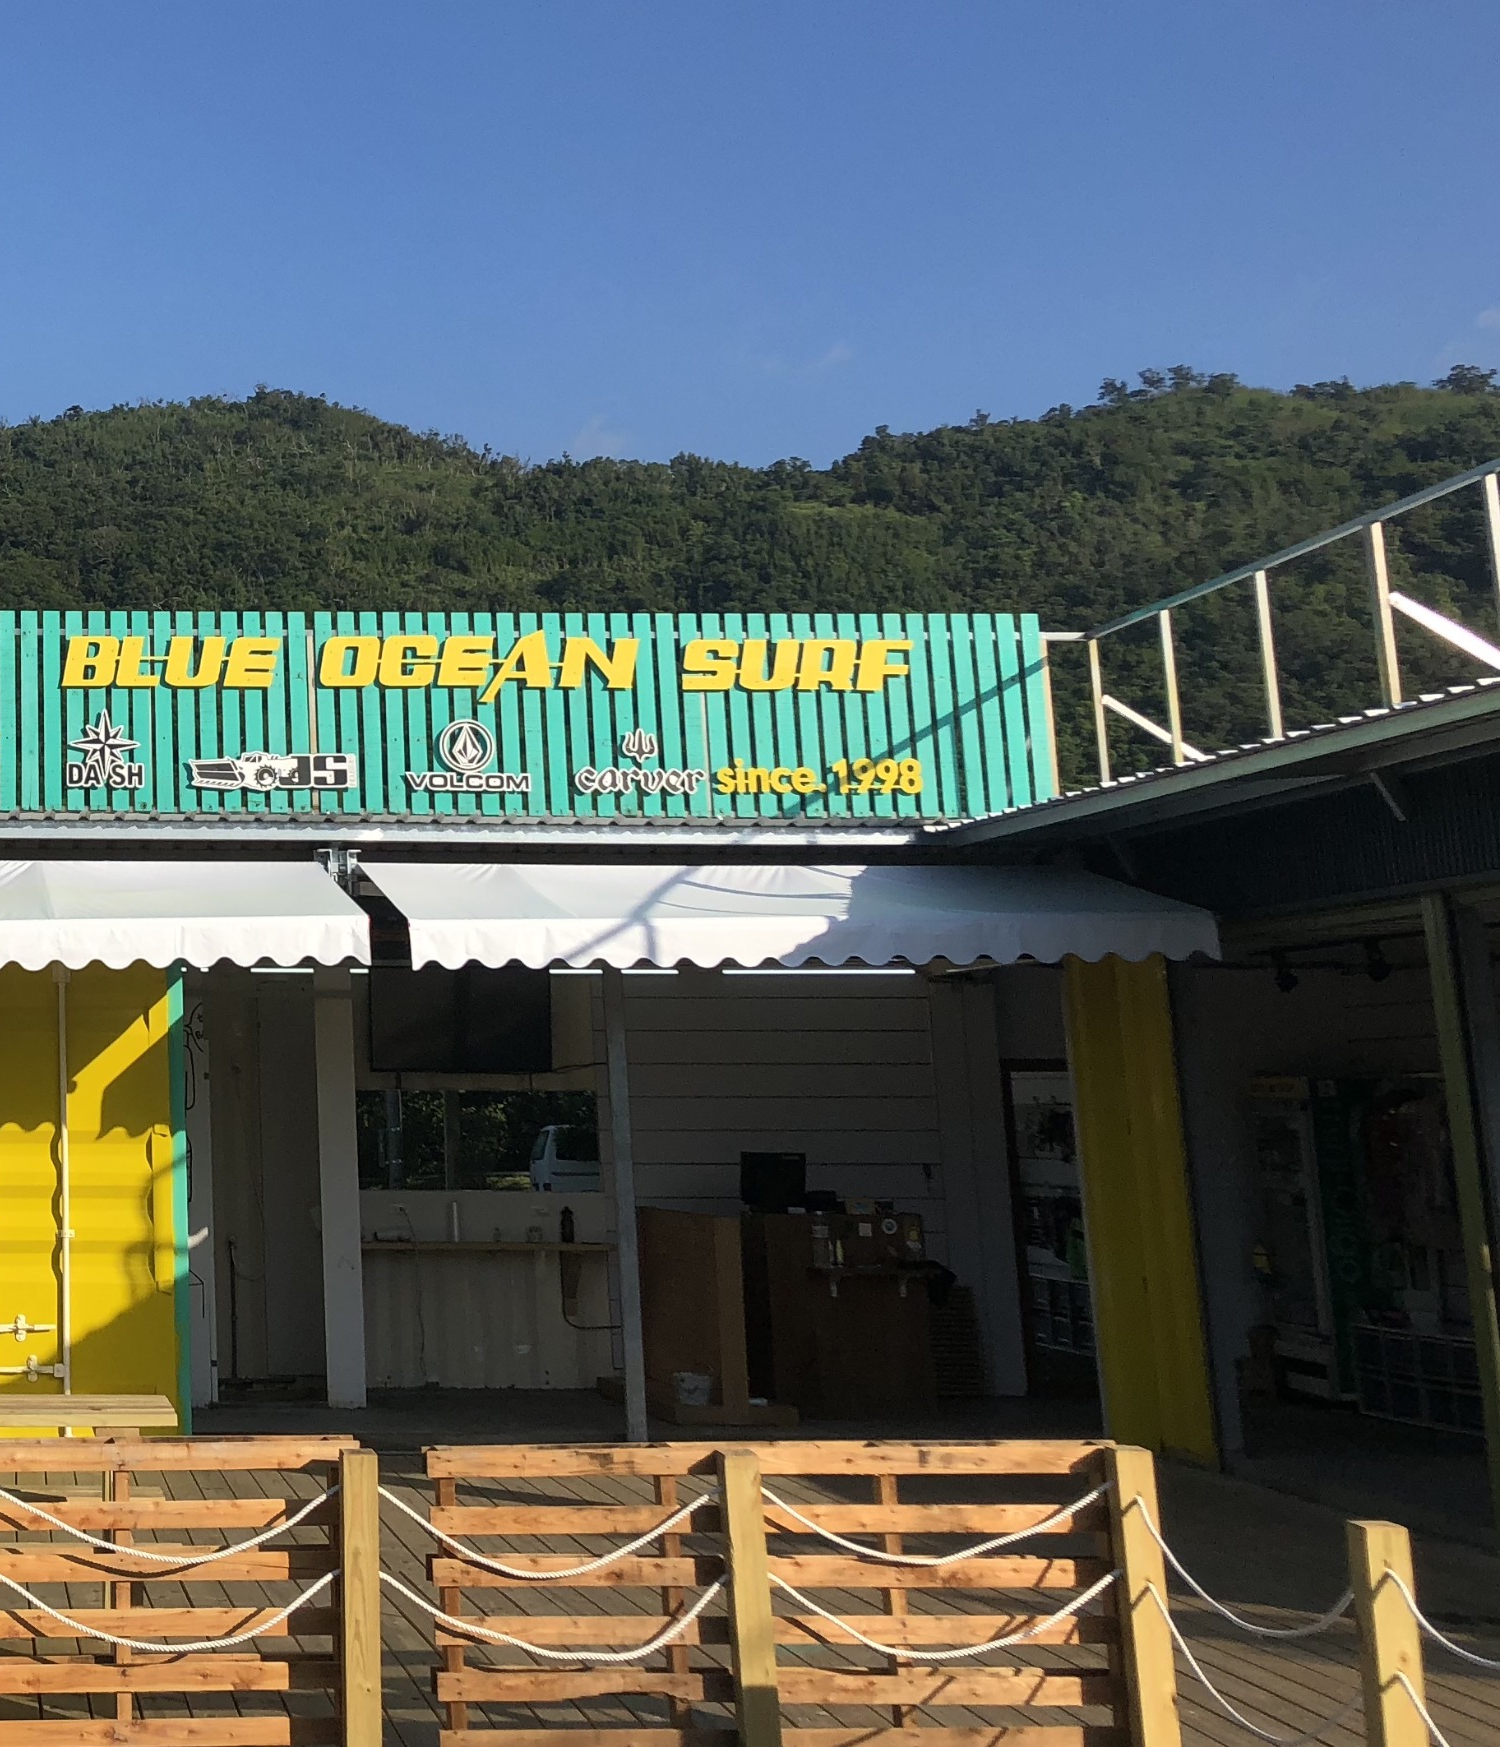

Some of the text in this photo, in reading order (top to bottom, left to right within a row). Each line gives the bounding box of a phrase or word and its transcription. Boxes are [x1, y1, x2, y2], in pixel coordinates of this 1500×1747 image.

[61, 630, 914, 703] BLUE OCEAN SURF
[68, 763, 144, 787] DASH
[407, 772, 530, 791] VOLCOM
[575, 766, 706, 794] carver
